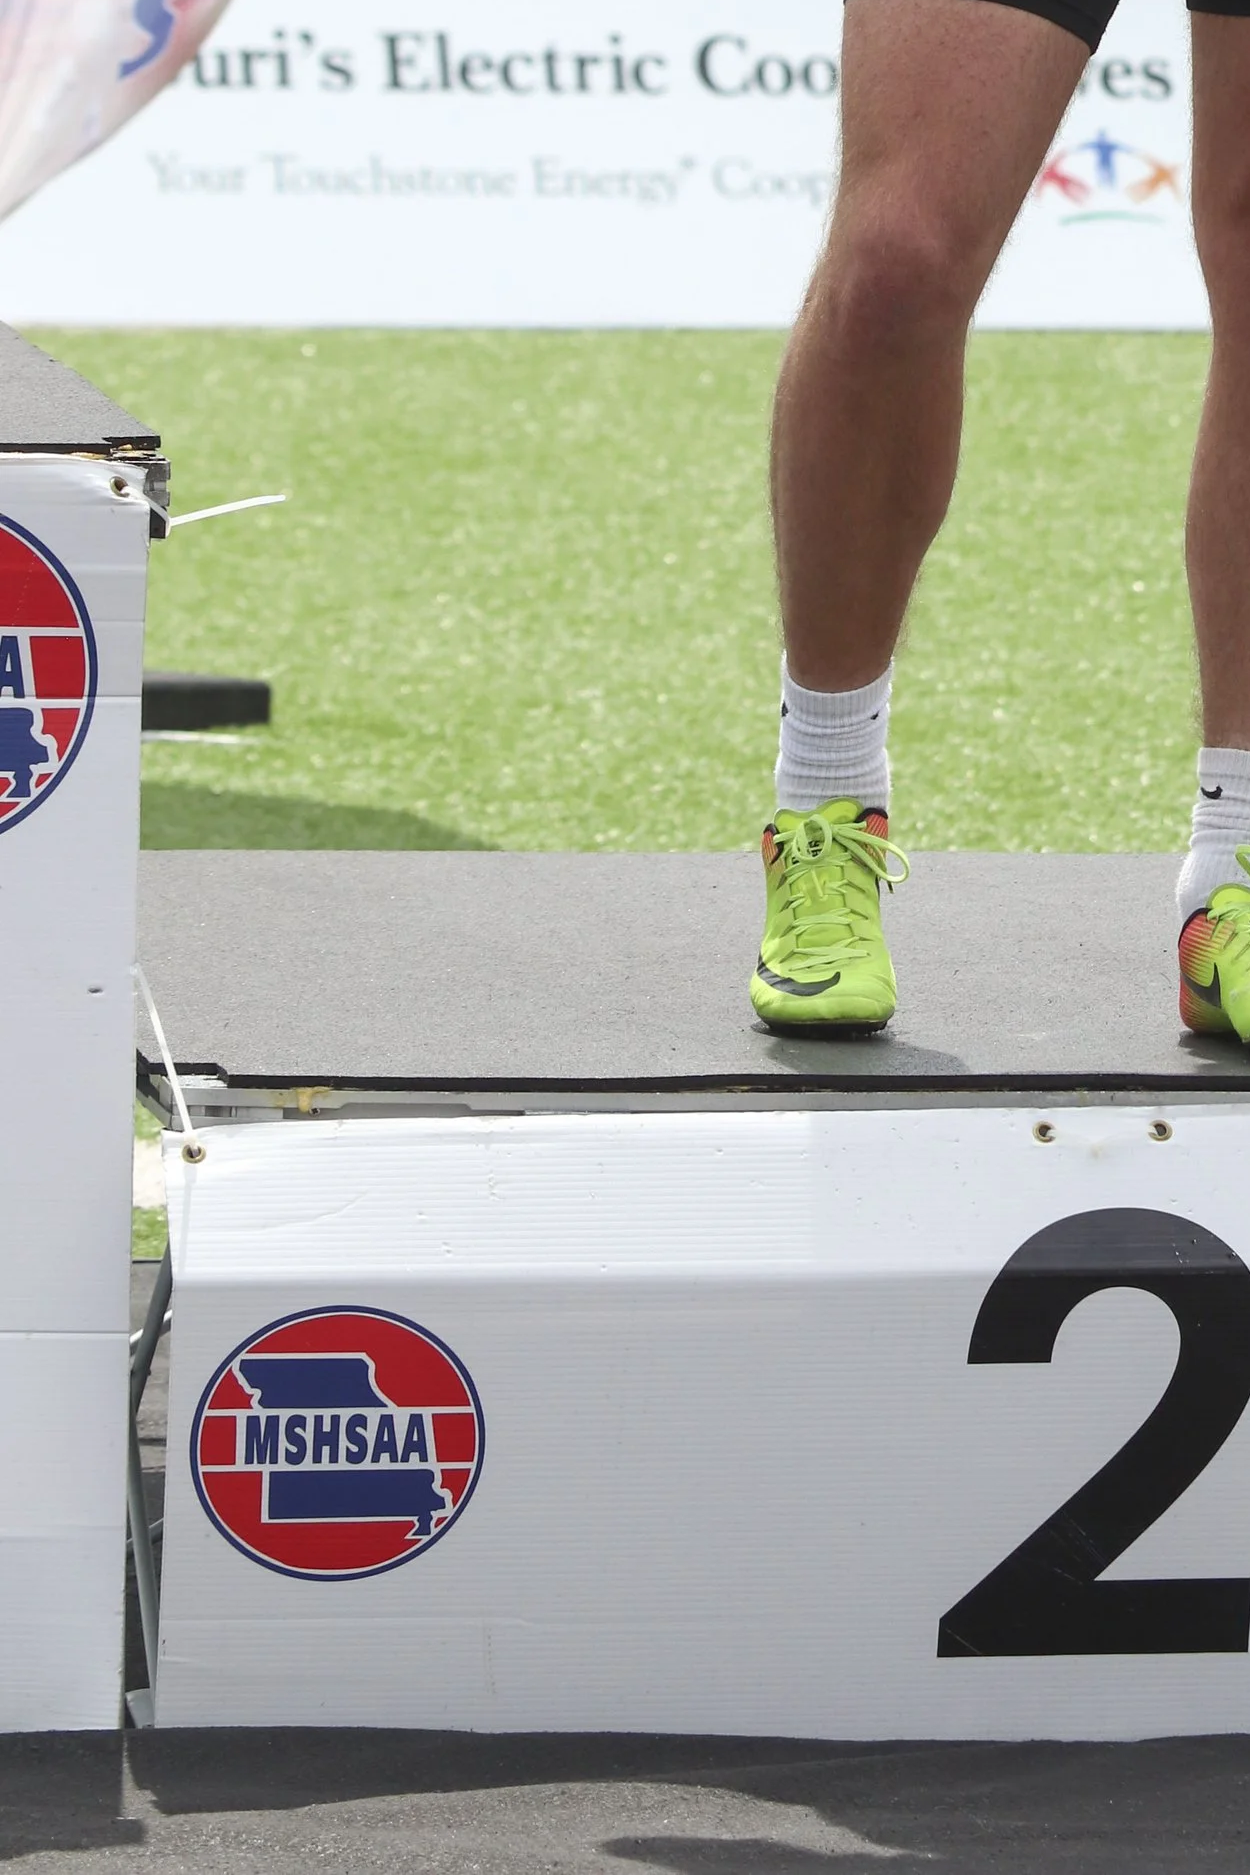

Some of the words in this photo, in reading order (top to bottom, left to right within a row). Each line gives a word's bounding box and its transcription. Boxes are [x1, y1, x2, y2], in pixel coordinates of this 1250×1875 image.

[381, 31, 667, 95] Electric
[146, 152, 247, 196] Your
[260, 152, 516, 197] Touchstone
[244, 1413, 429, 1466] MSHSAA
